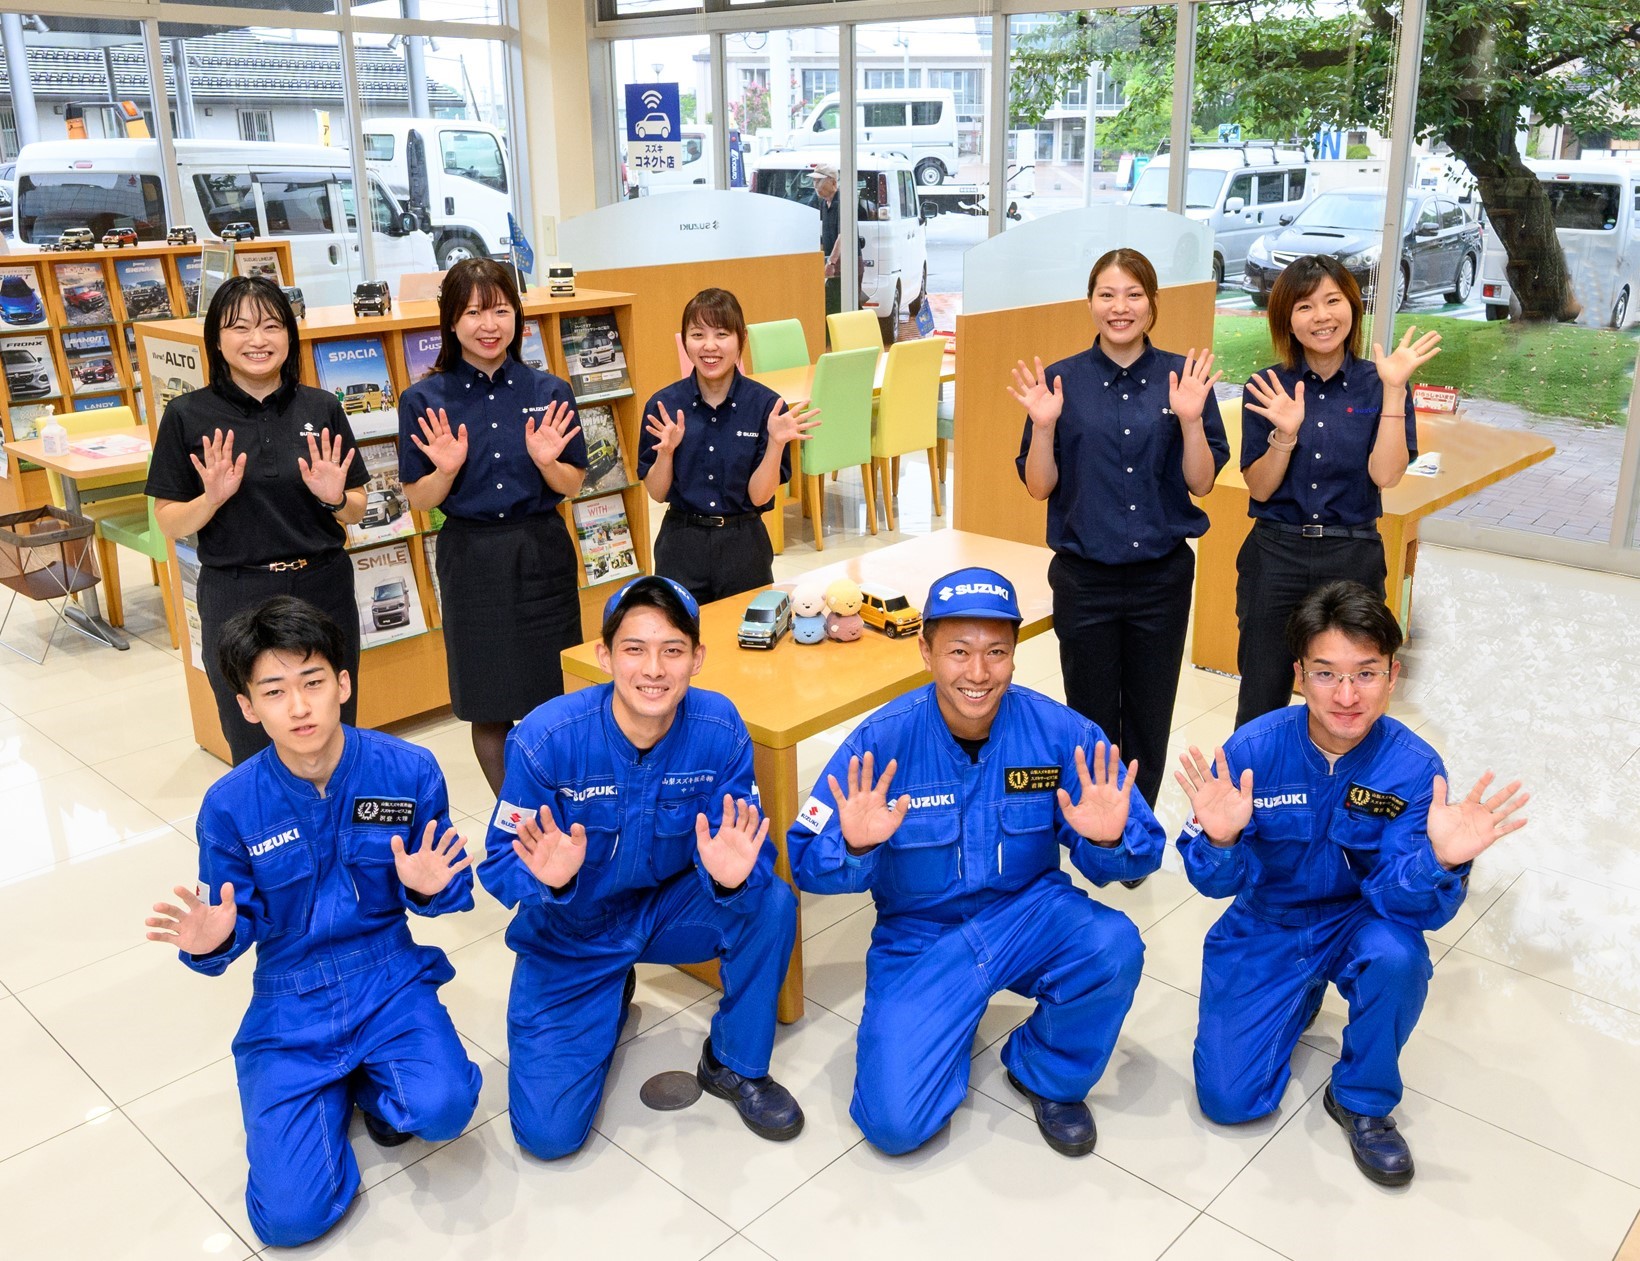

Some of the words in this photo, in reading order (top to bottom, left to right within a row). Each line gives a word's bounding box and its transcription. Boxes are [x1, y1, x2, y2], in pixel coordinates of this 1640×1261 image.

[645, 144, 663, 154] スズキ
[635, 155, 675, 169] コネクト店
[125, 266, 155, 274] SIERRA
[6, 340, 43, 348] FRONX
[69, 335, 104, 344] BANDIT
[418, 339, 442, 352] Cus
[165, 351, 196, 370] ALTO
[328, 347, 378, 363] SPACIA
[84, 401, 114, 410] LANDY
[588, 505, 608, 516] WITH
[357, 550, 407, 571] SMILE
[954, 583, 1009, 601] SUZUKI
[1014, 771, 1021, 785] 1
[908, 793, 955, 810] UZUKI
[1253, 793, 1308, 809] SUZUKI
[1356, 789, 1364, 802] 1
[364, 801, 372, 814] 2
[501, 819, 517, 829] SUZ
[801, 812, 819, 828] SUZUKI
